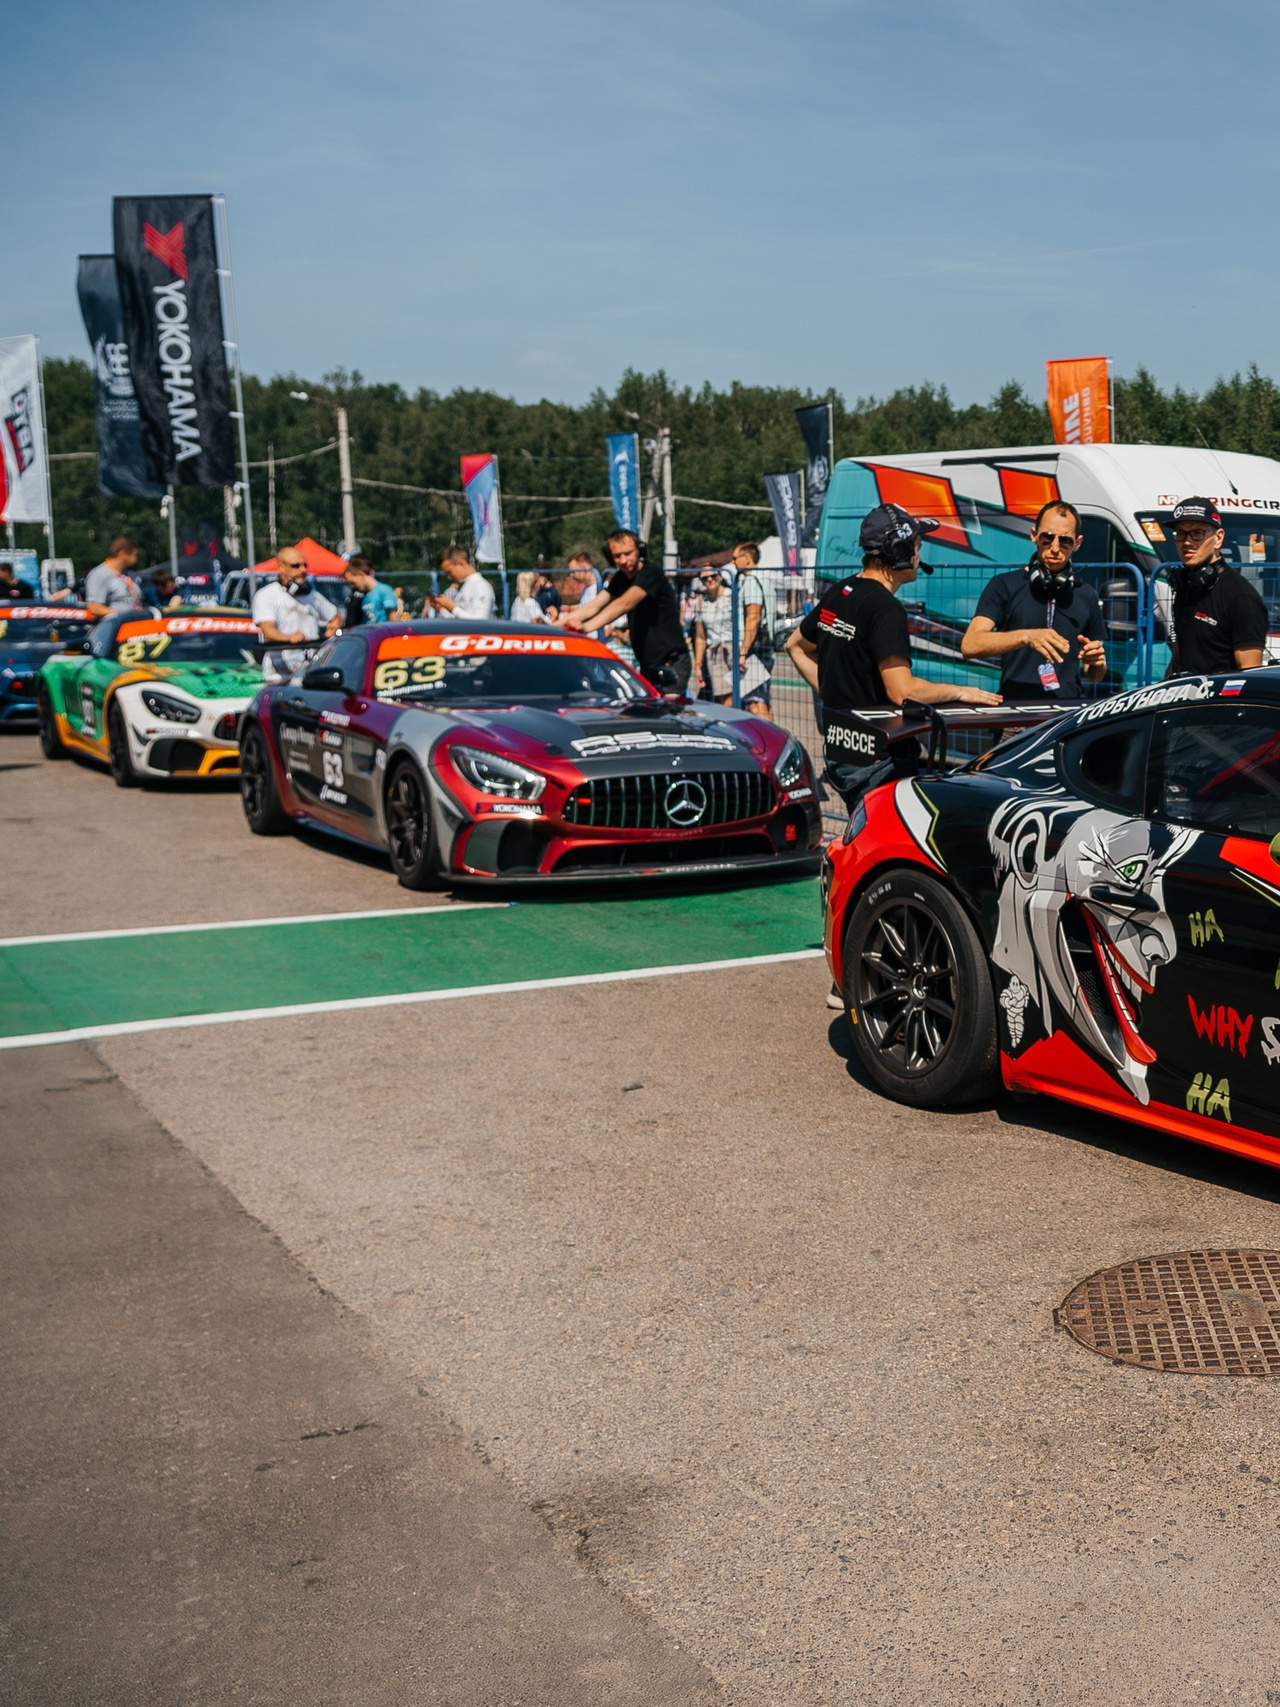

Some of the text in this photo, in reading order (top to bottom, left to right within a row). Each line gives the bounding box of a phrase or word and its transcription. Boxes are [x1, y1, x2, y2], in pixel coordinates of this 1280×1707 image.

[153, 279, 202, 463] YOKOHAMA
[118, 635, 172, 666] 87
[374, 655, 447, 690] 63
[851, 703, 1087, 721] PRSCH
[826, 724, 876, 755] #PSCCE
[323, 750, 344, 788] 63
[1188, 908, 1225, 947] HA
[1187, 994, 1254, 1058] WHY
[1185, 1071, 1232, 1123] HA
